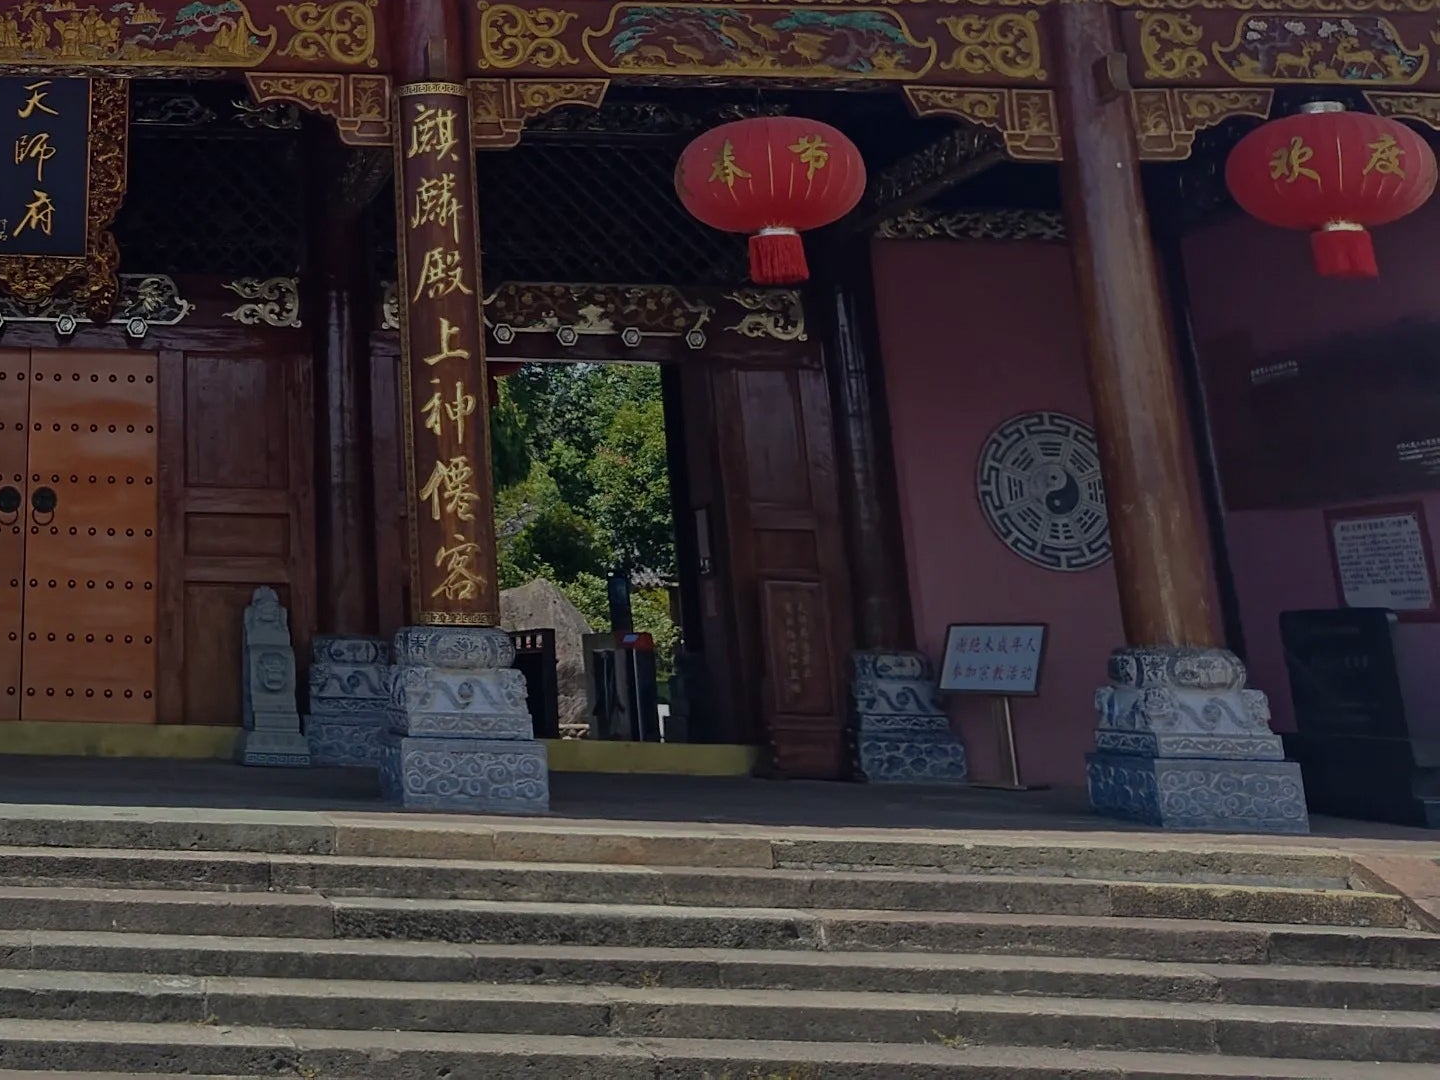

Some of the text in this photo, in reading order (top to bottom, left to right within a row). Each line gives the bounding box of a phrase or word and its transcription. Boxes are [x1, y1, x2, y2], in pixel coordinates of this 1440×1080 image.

[12, 79, 60, 238] 天師府
[708, 134, 830, 189] 春节
[1268, 134, 1407, 184] 欢度
